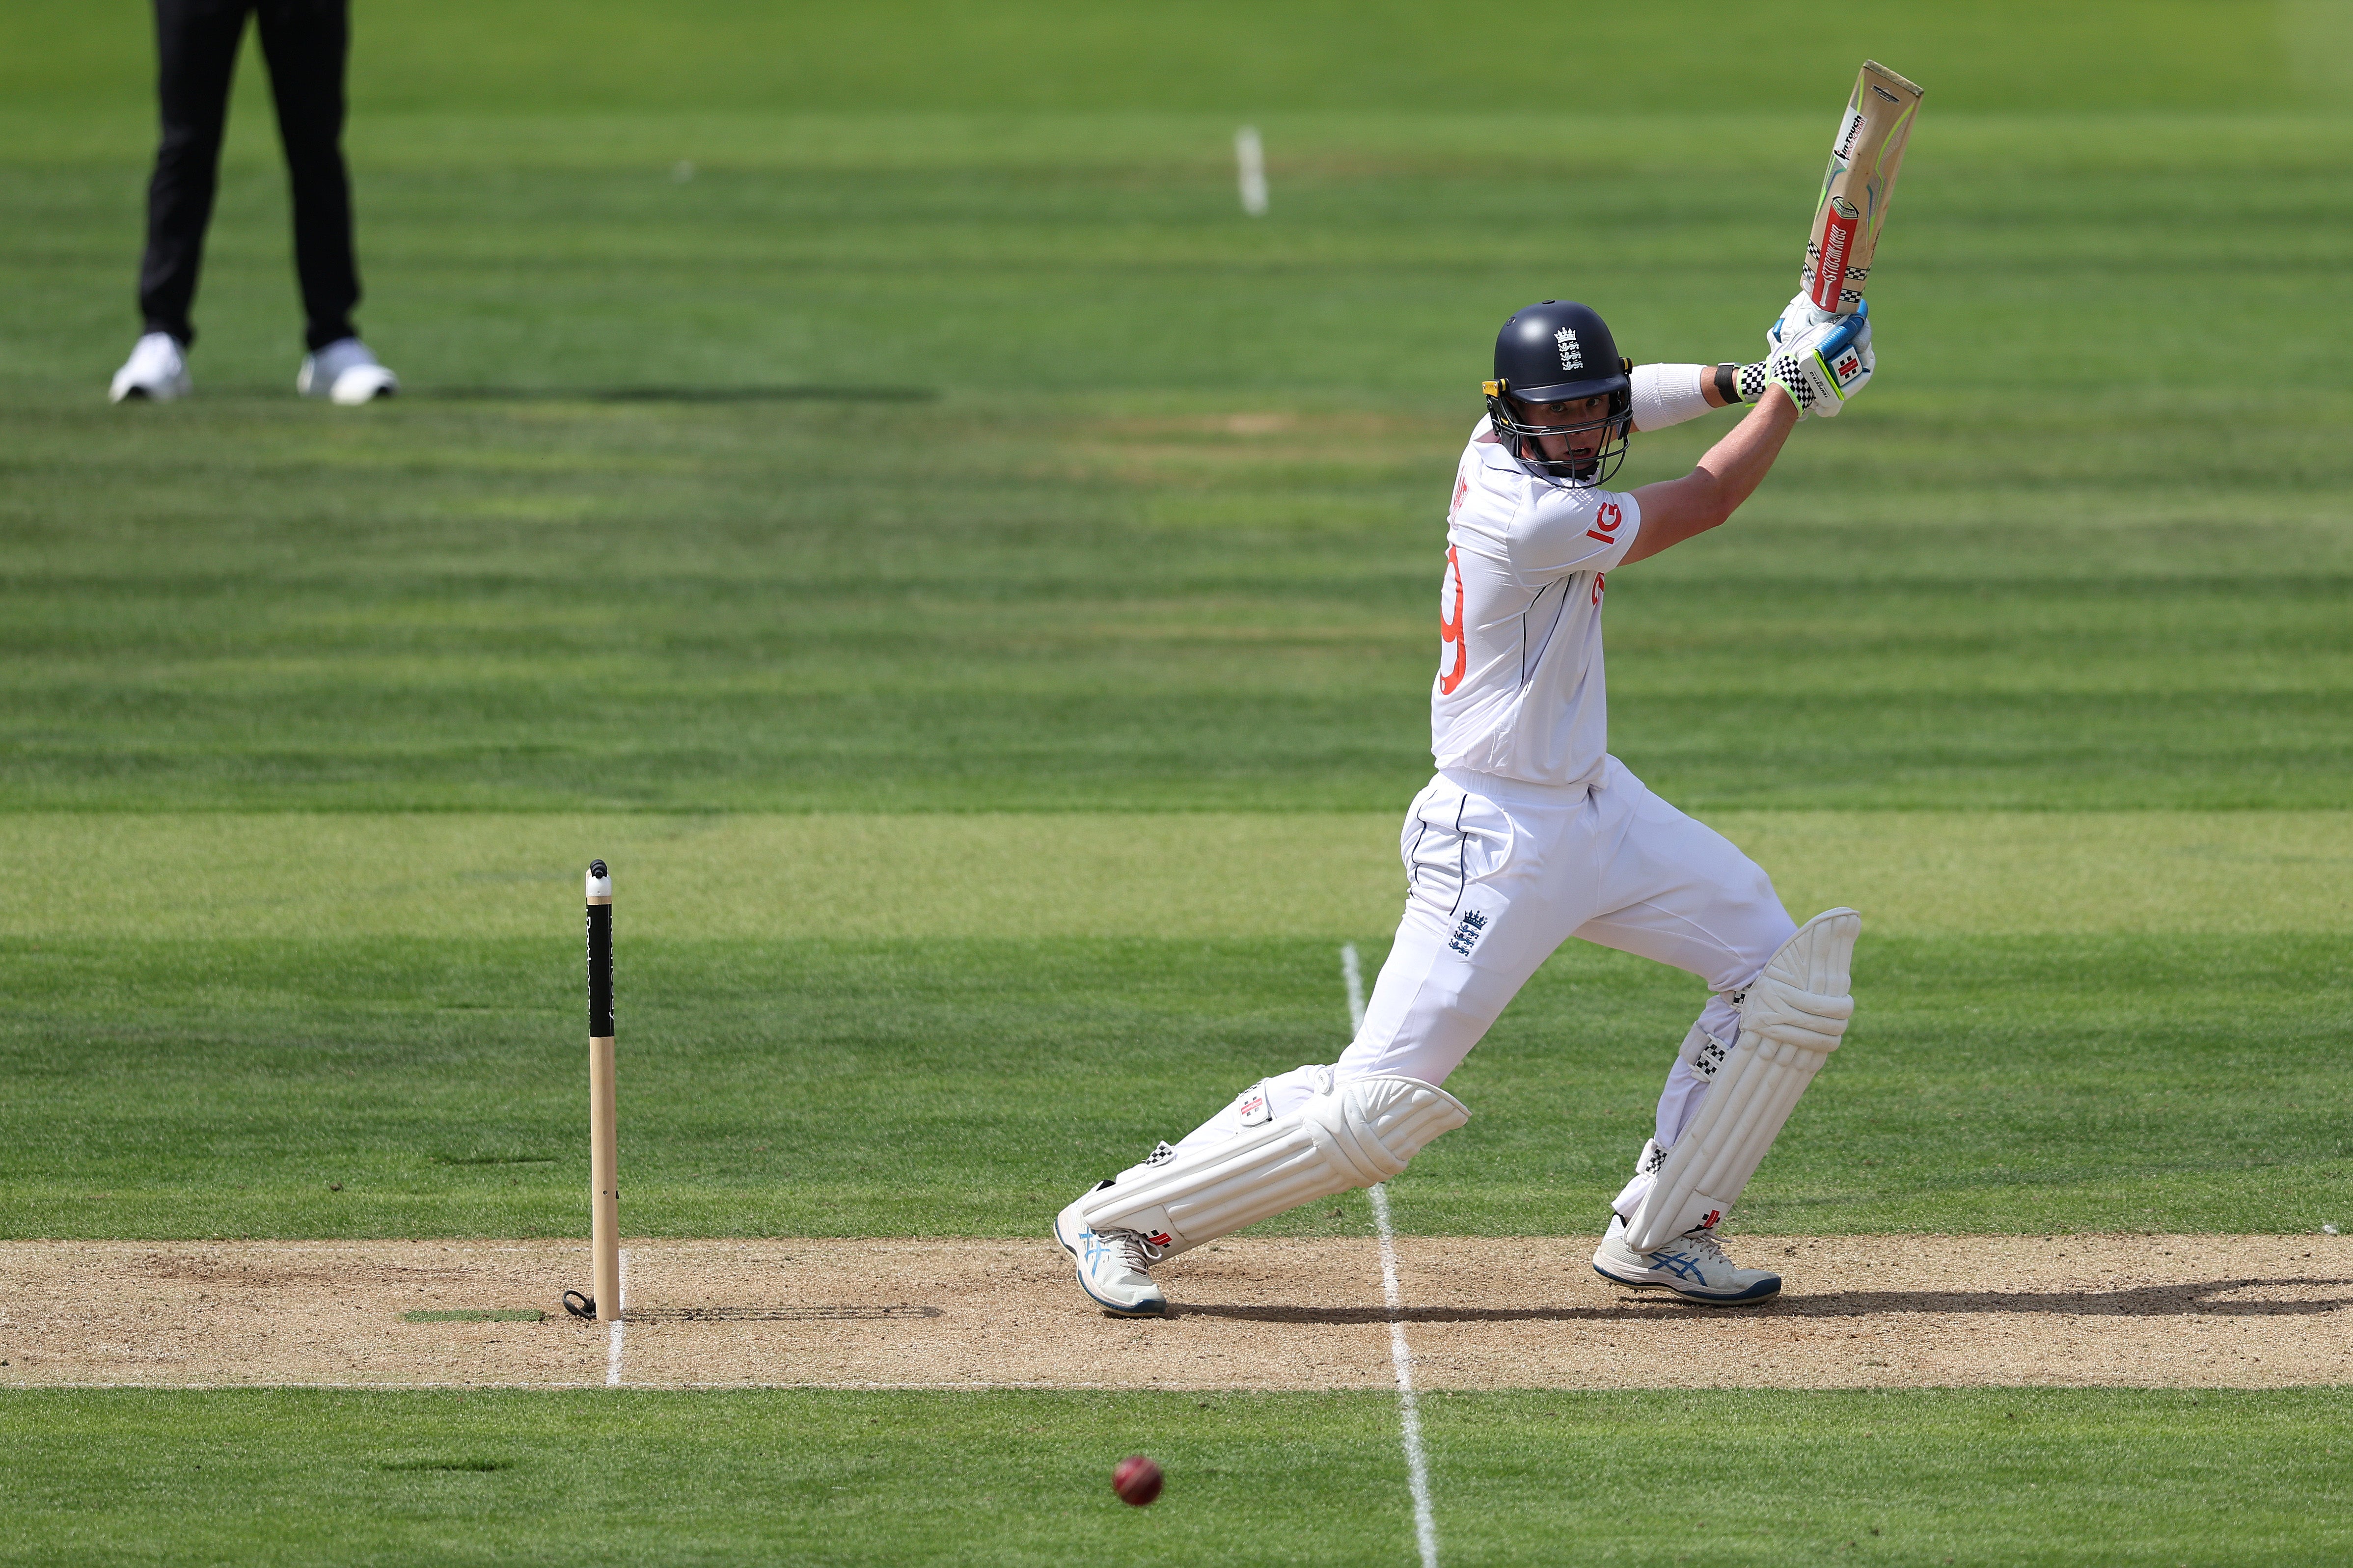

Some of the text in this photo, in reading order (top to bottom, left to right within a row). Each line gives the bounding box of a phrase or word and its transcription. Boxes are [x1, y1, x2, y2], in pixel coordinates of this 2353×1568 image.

[1852, 118, 1865, 142] ACADEMY
[1812, 376, 1828, 398] TEMPESTA
[1586, 502, 1622, 545] IG
